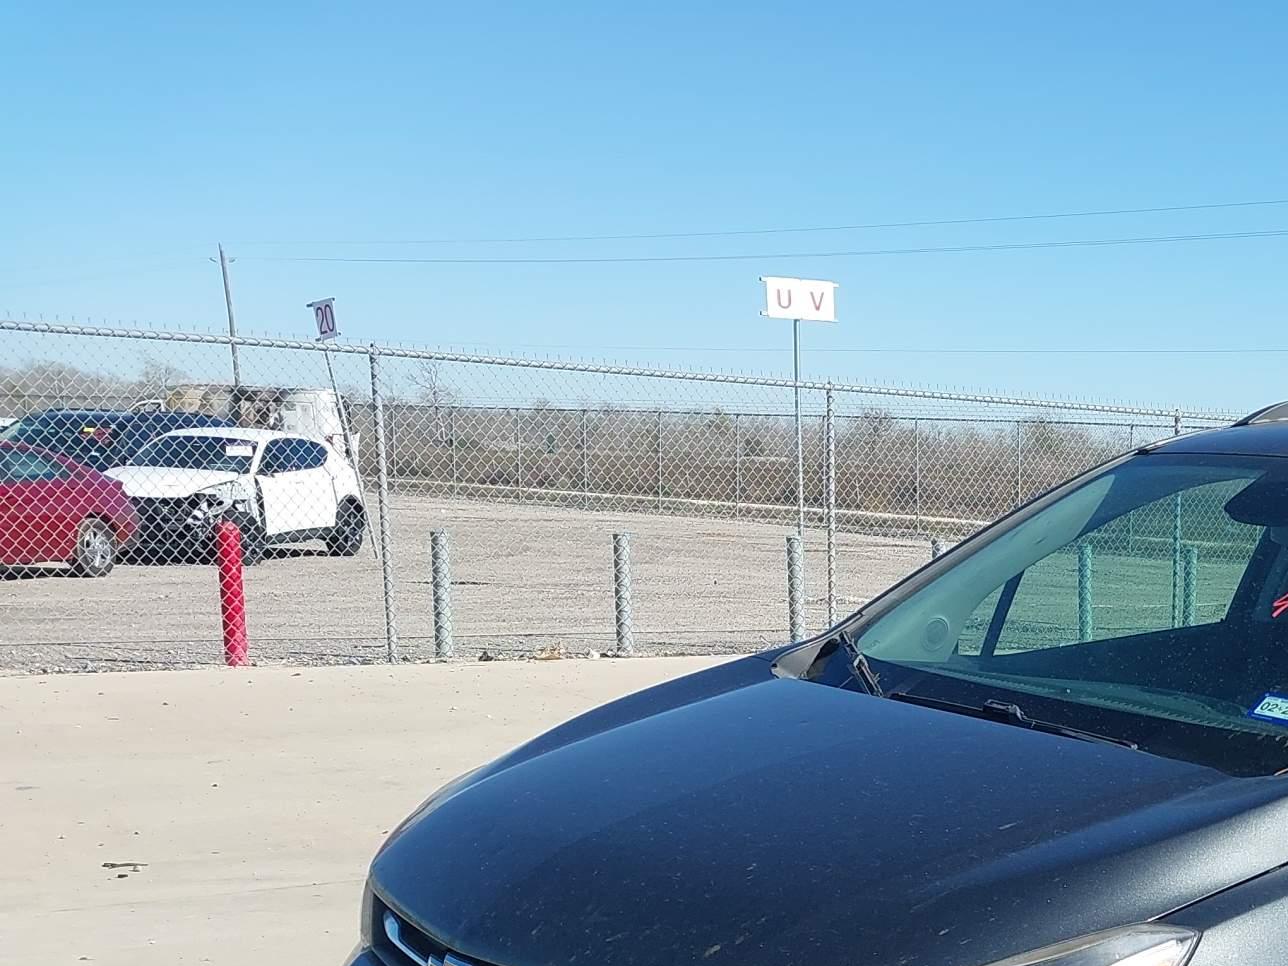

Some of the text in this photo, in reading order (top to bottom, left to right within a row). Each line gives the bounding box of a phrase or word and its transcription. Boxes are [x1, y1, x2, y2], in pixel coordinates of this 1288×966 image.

[776, 288, 825, 311] U V
[315, 304, 334, 335] 20
